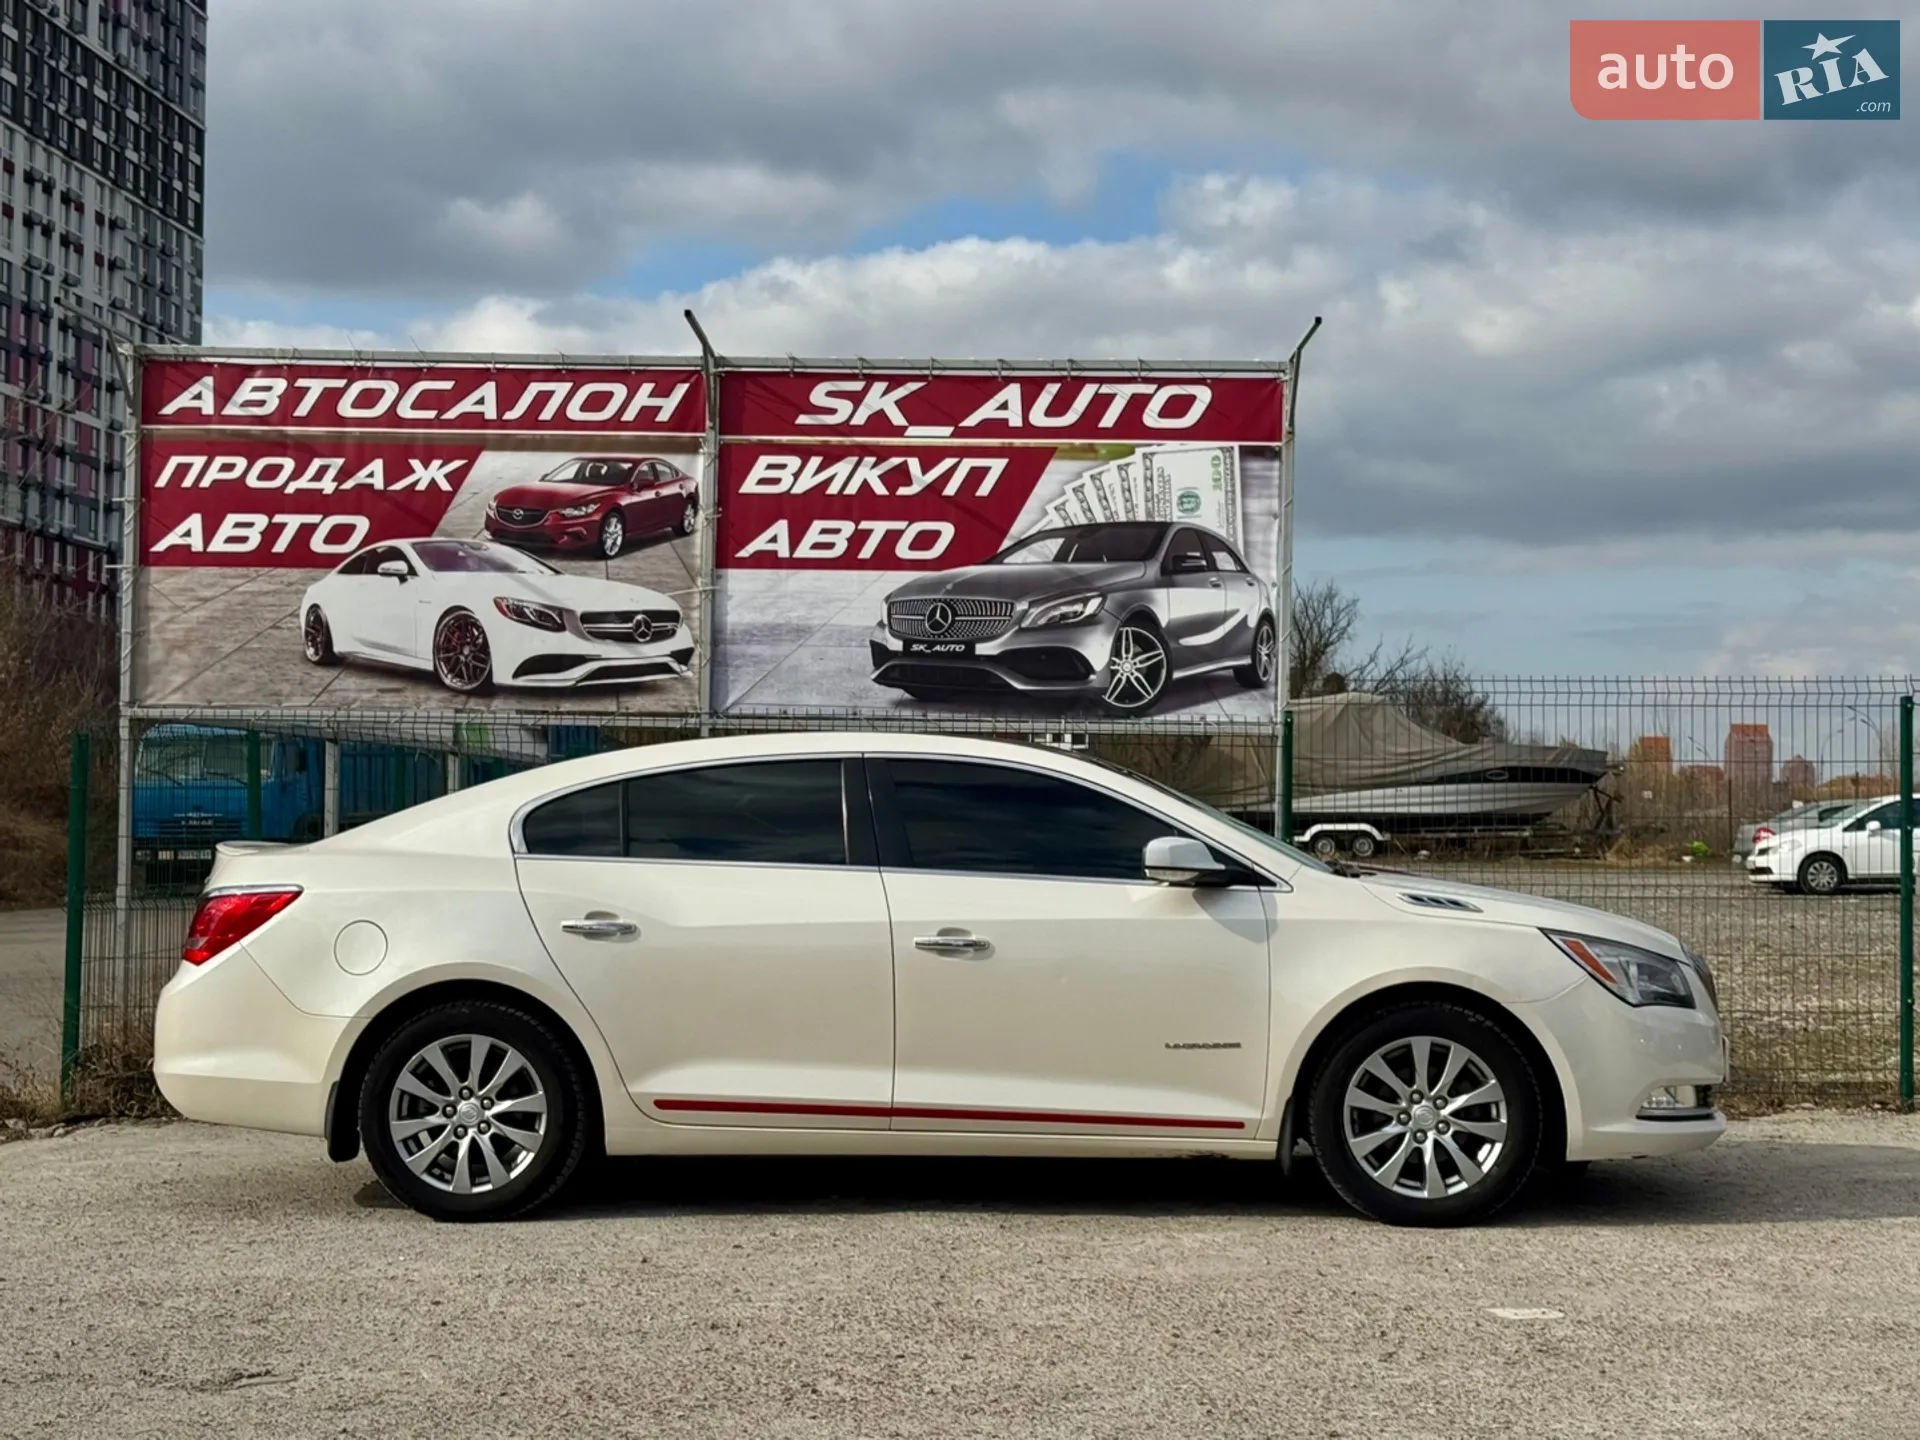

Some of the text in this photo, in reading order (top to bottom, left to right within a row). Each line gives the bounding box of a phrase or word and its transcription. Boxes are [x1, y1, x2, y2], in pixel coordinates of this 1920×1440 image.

[158, 375, 691, 423] АВТОСАЛОН
[794, 381, 1213, 438] SK_AUTO
[154, 455, 469, 495] ПРОДАЖ
[738, 455, 1009, 498] ВИКУП
[149, 513, 371, 554] АВТО
[735, 519, 956, 560] АВТО
[909, 642, 967, 654] SK_AUTO
